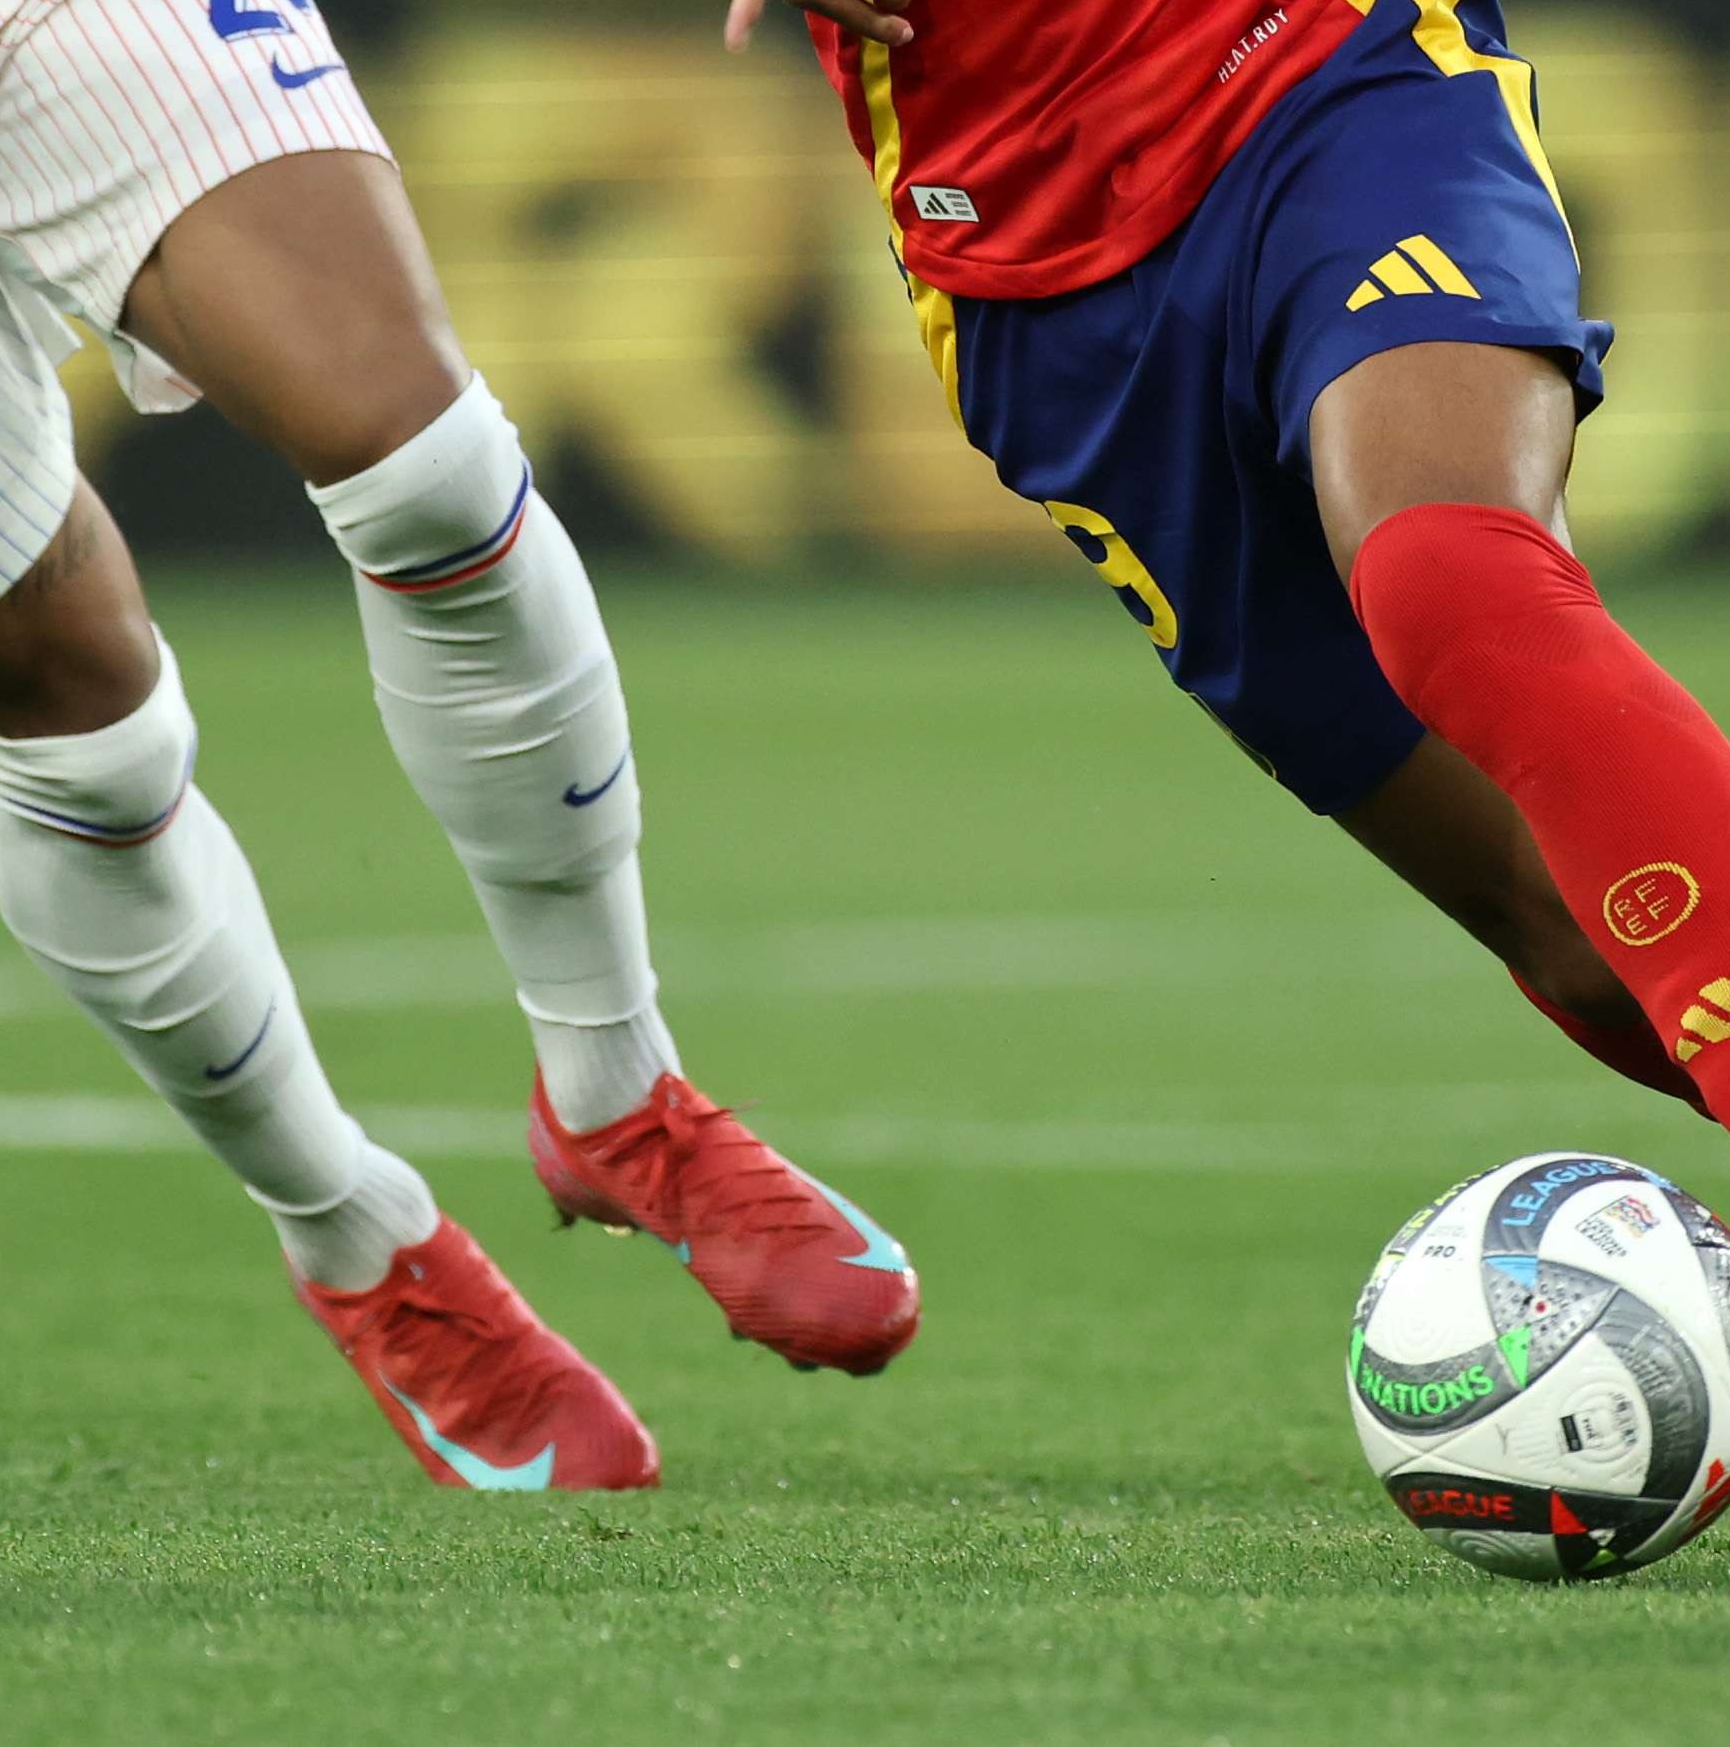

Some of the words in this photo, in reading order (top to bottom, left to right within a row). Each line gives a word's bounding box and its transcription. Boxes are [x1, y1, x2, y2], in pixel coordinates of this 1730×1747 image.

[1501, 1160, 1620, 1227] LEAGUE
[1421, 1244, 1457, 1259] PRO
[1360, 1363, 1497, 1416] NATIONS
